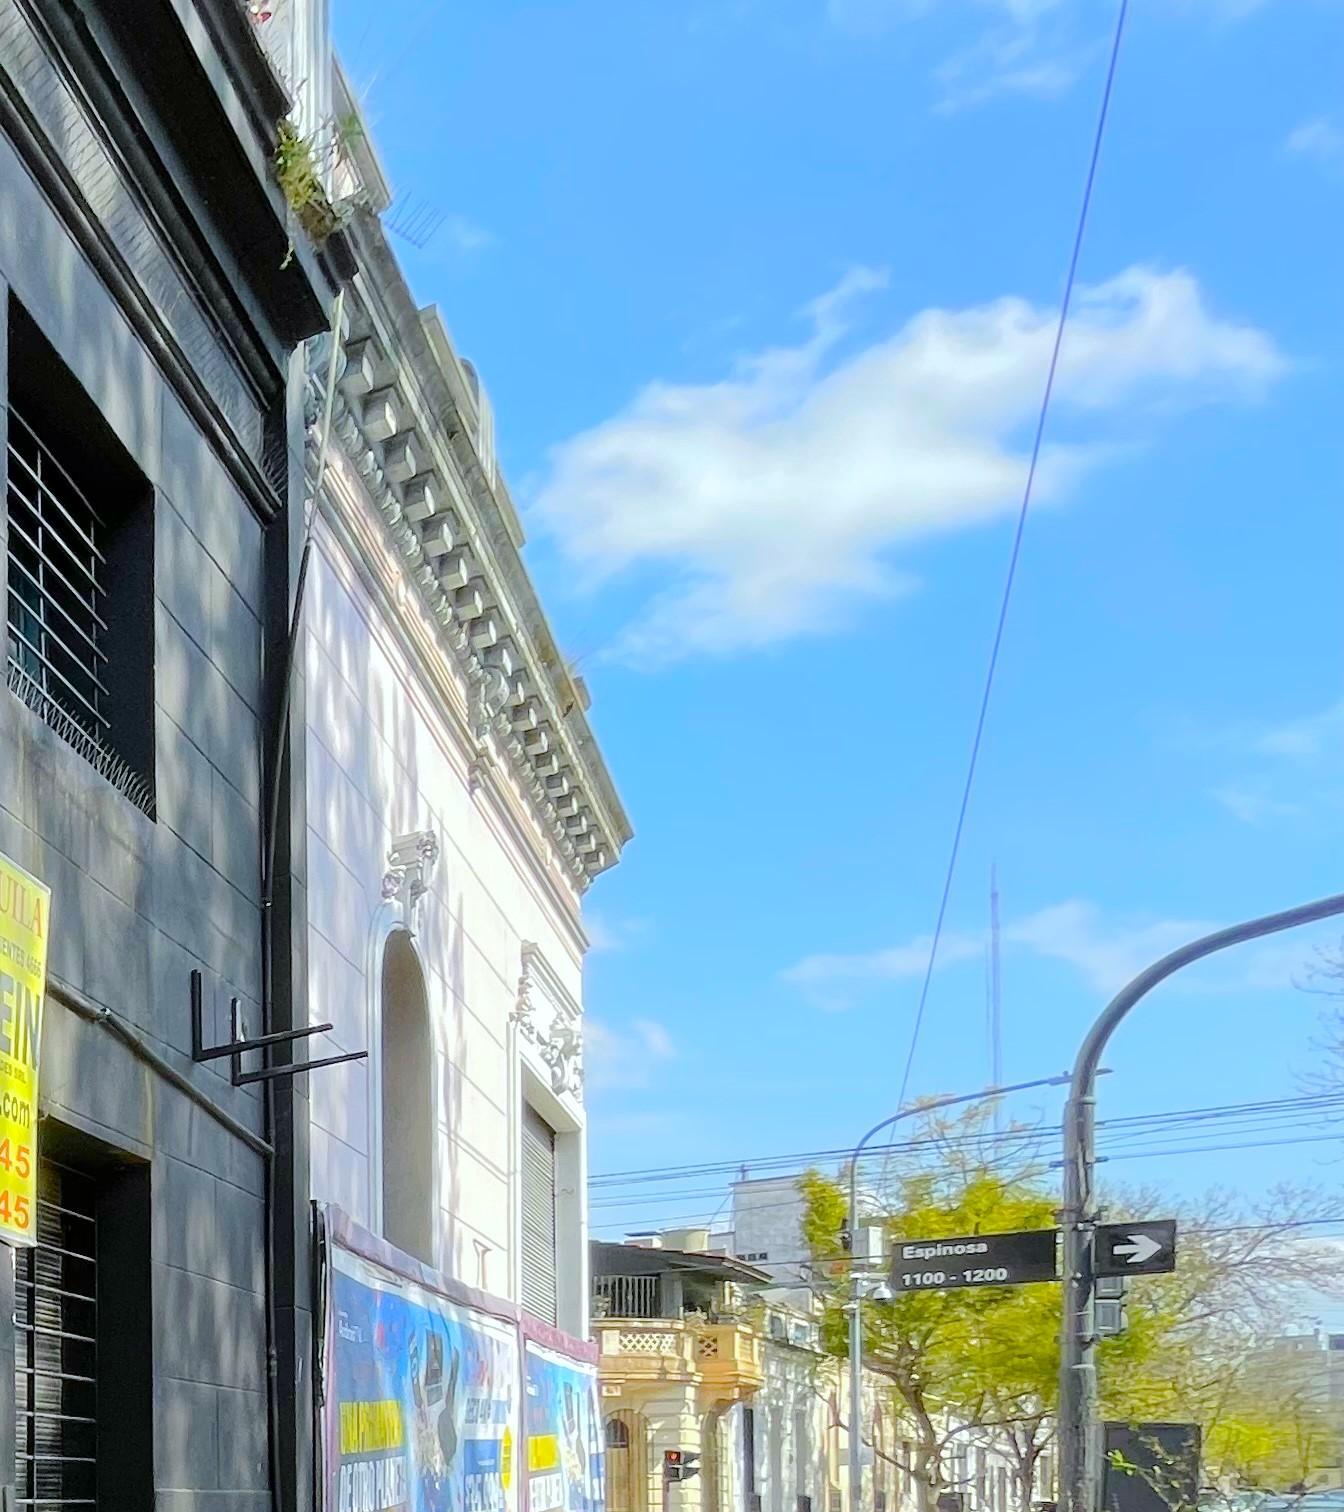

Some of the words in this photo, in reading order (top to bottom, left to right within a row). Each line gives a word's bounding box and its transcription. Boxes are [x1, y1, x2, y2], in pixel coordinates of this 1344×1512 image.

[902, 1242, 989, 1260] Espinosa
[902, 1271, 946, 1287] 1100
[963, 1267, 1008, 1283] 1200
